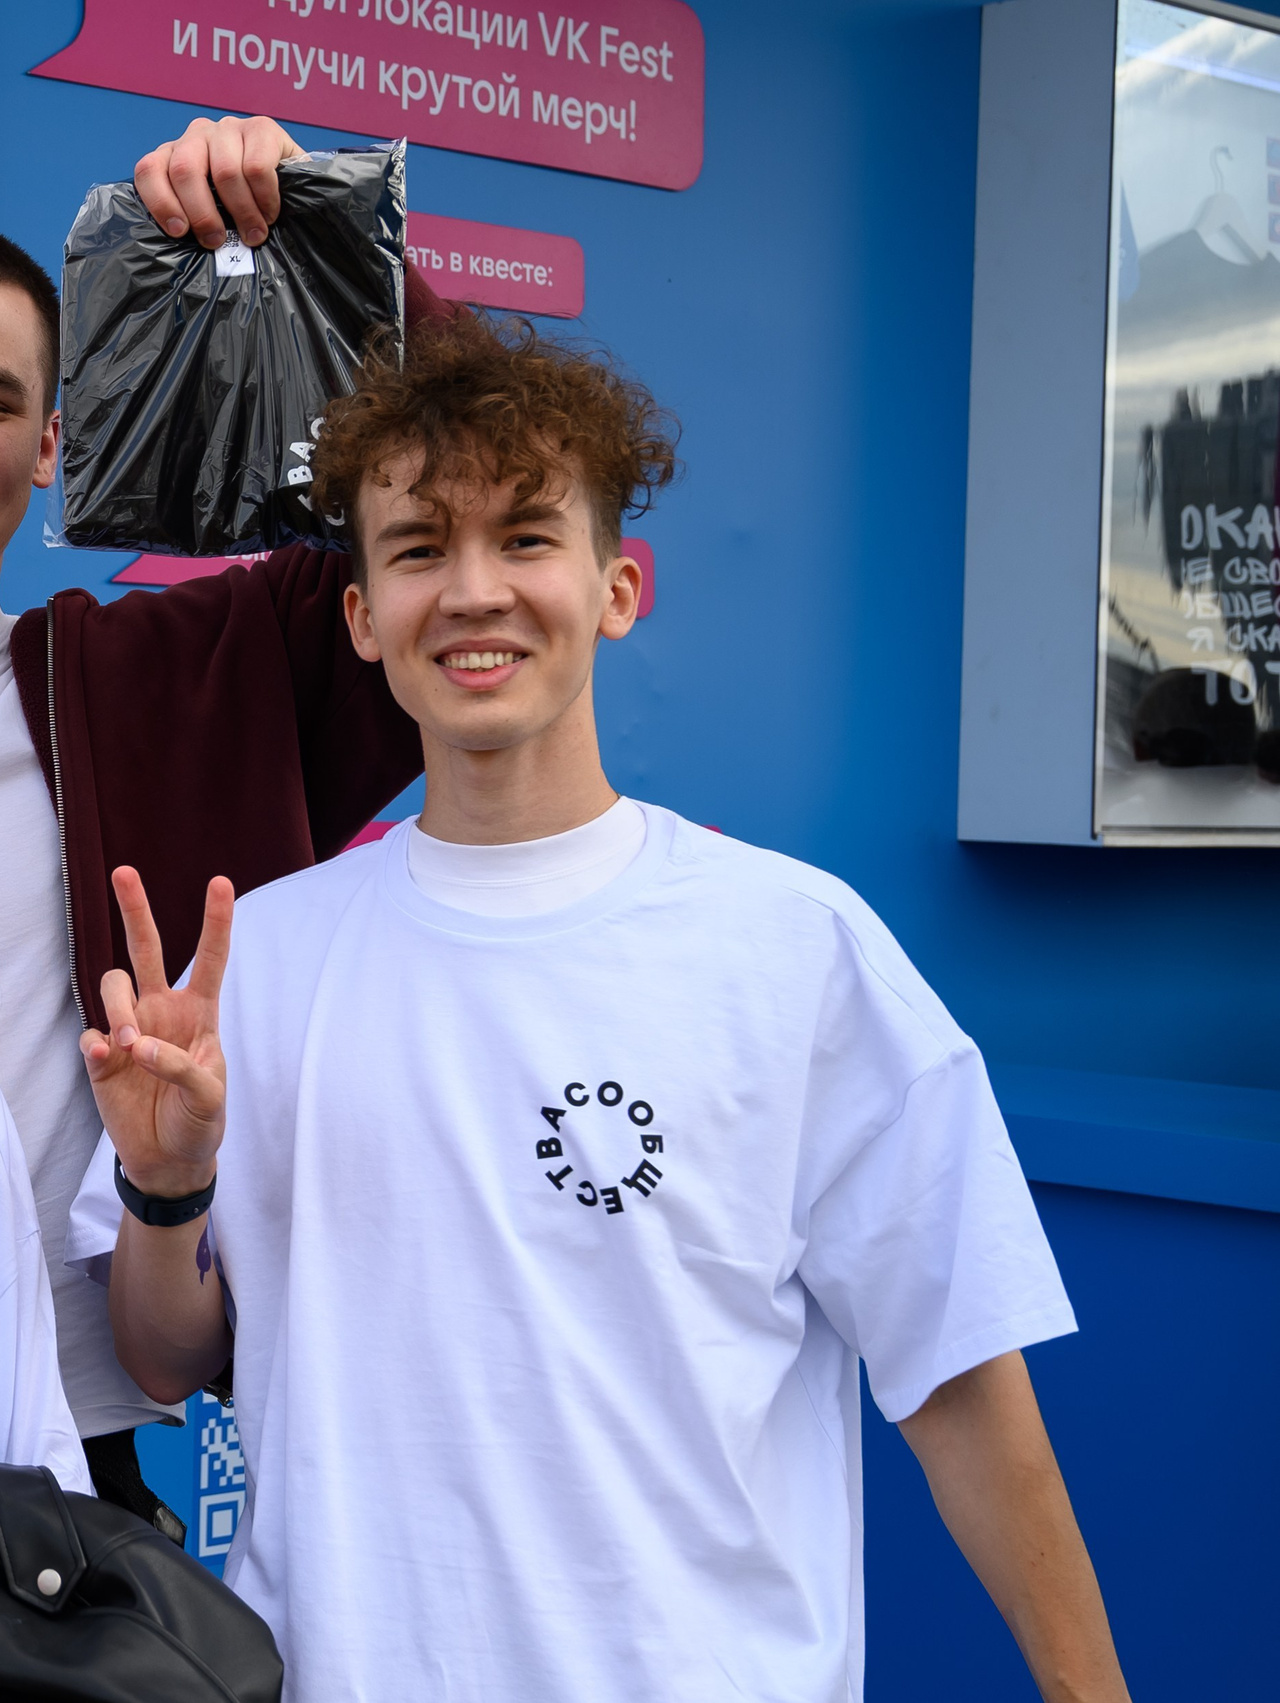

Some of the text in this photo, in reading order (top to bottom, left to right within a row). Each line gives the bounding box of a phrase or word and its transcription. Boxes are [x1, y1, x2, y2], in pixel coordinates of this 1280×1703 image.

[172, 18, 638, 145] и получи крутой мерч!
[537, 12, 591, 65] VK
[599, 25, 674, 82] Fest
[229, 255, 242, 263] XL
[405, 245, 554, 288] ать в квесте:
[535, 1080, 664, 1215] СООБЩЕСТВА
